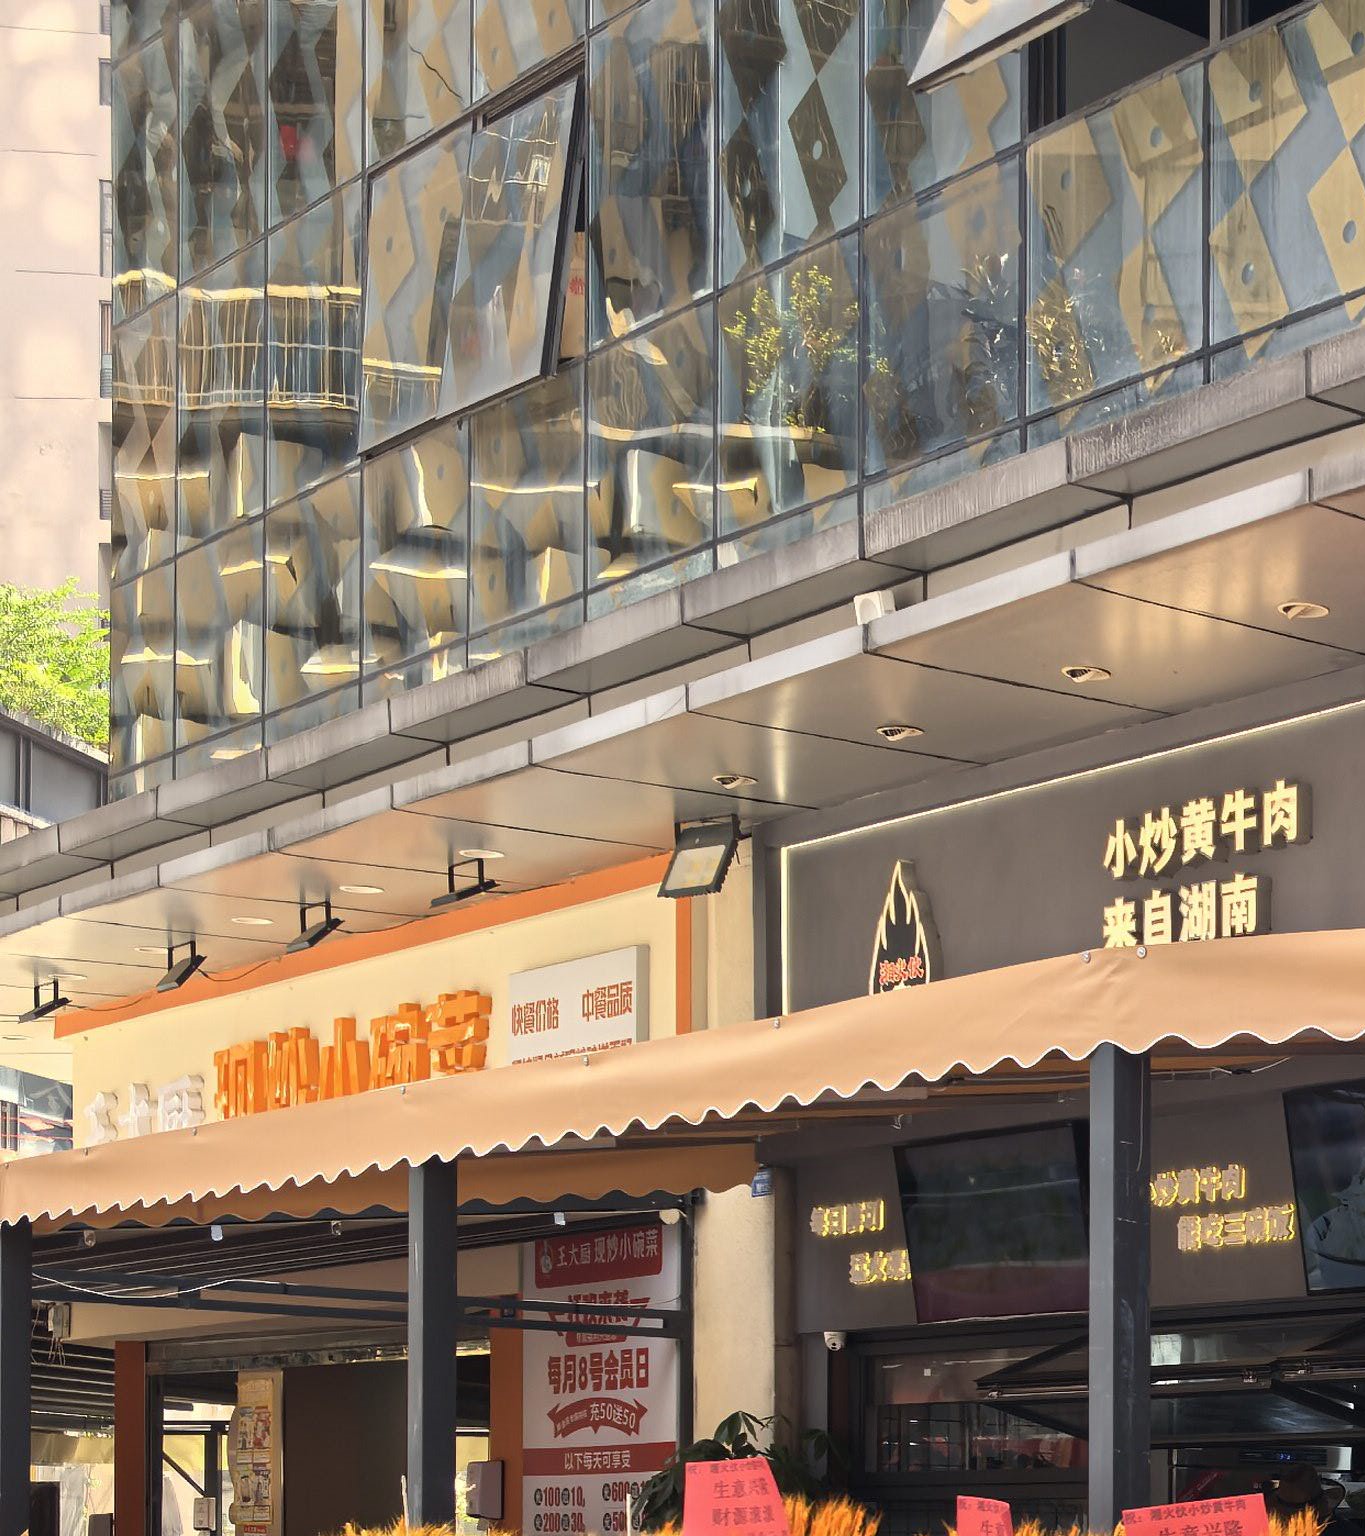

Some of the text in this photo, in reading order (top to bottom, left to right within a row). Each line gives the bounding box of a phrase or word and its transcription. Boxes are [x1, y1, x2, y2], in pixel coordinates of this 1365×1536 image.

[1103, 779, 1300, 880] 小炒黄牛肉
[1103, 872, 1259, 948] 来自湖南
[512, 981, 633, 1036] 快餐价格 中餐品质
[548, 1348, 650, 1394] 每月8号会员日
[564, 1449, 632, 1470] 以下每天可享受
